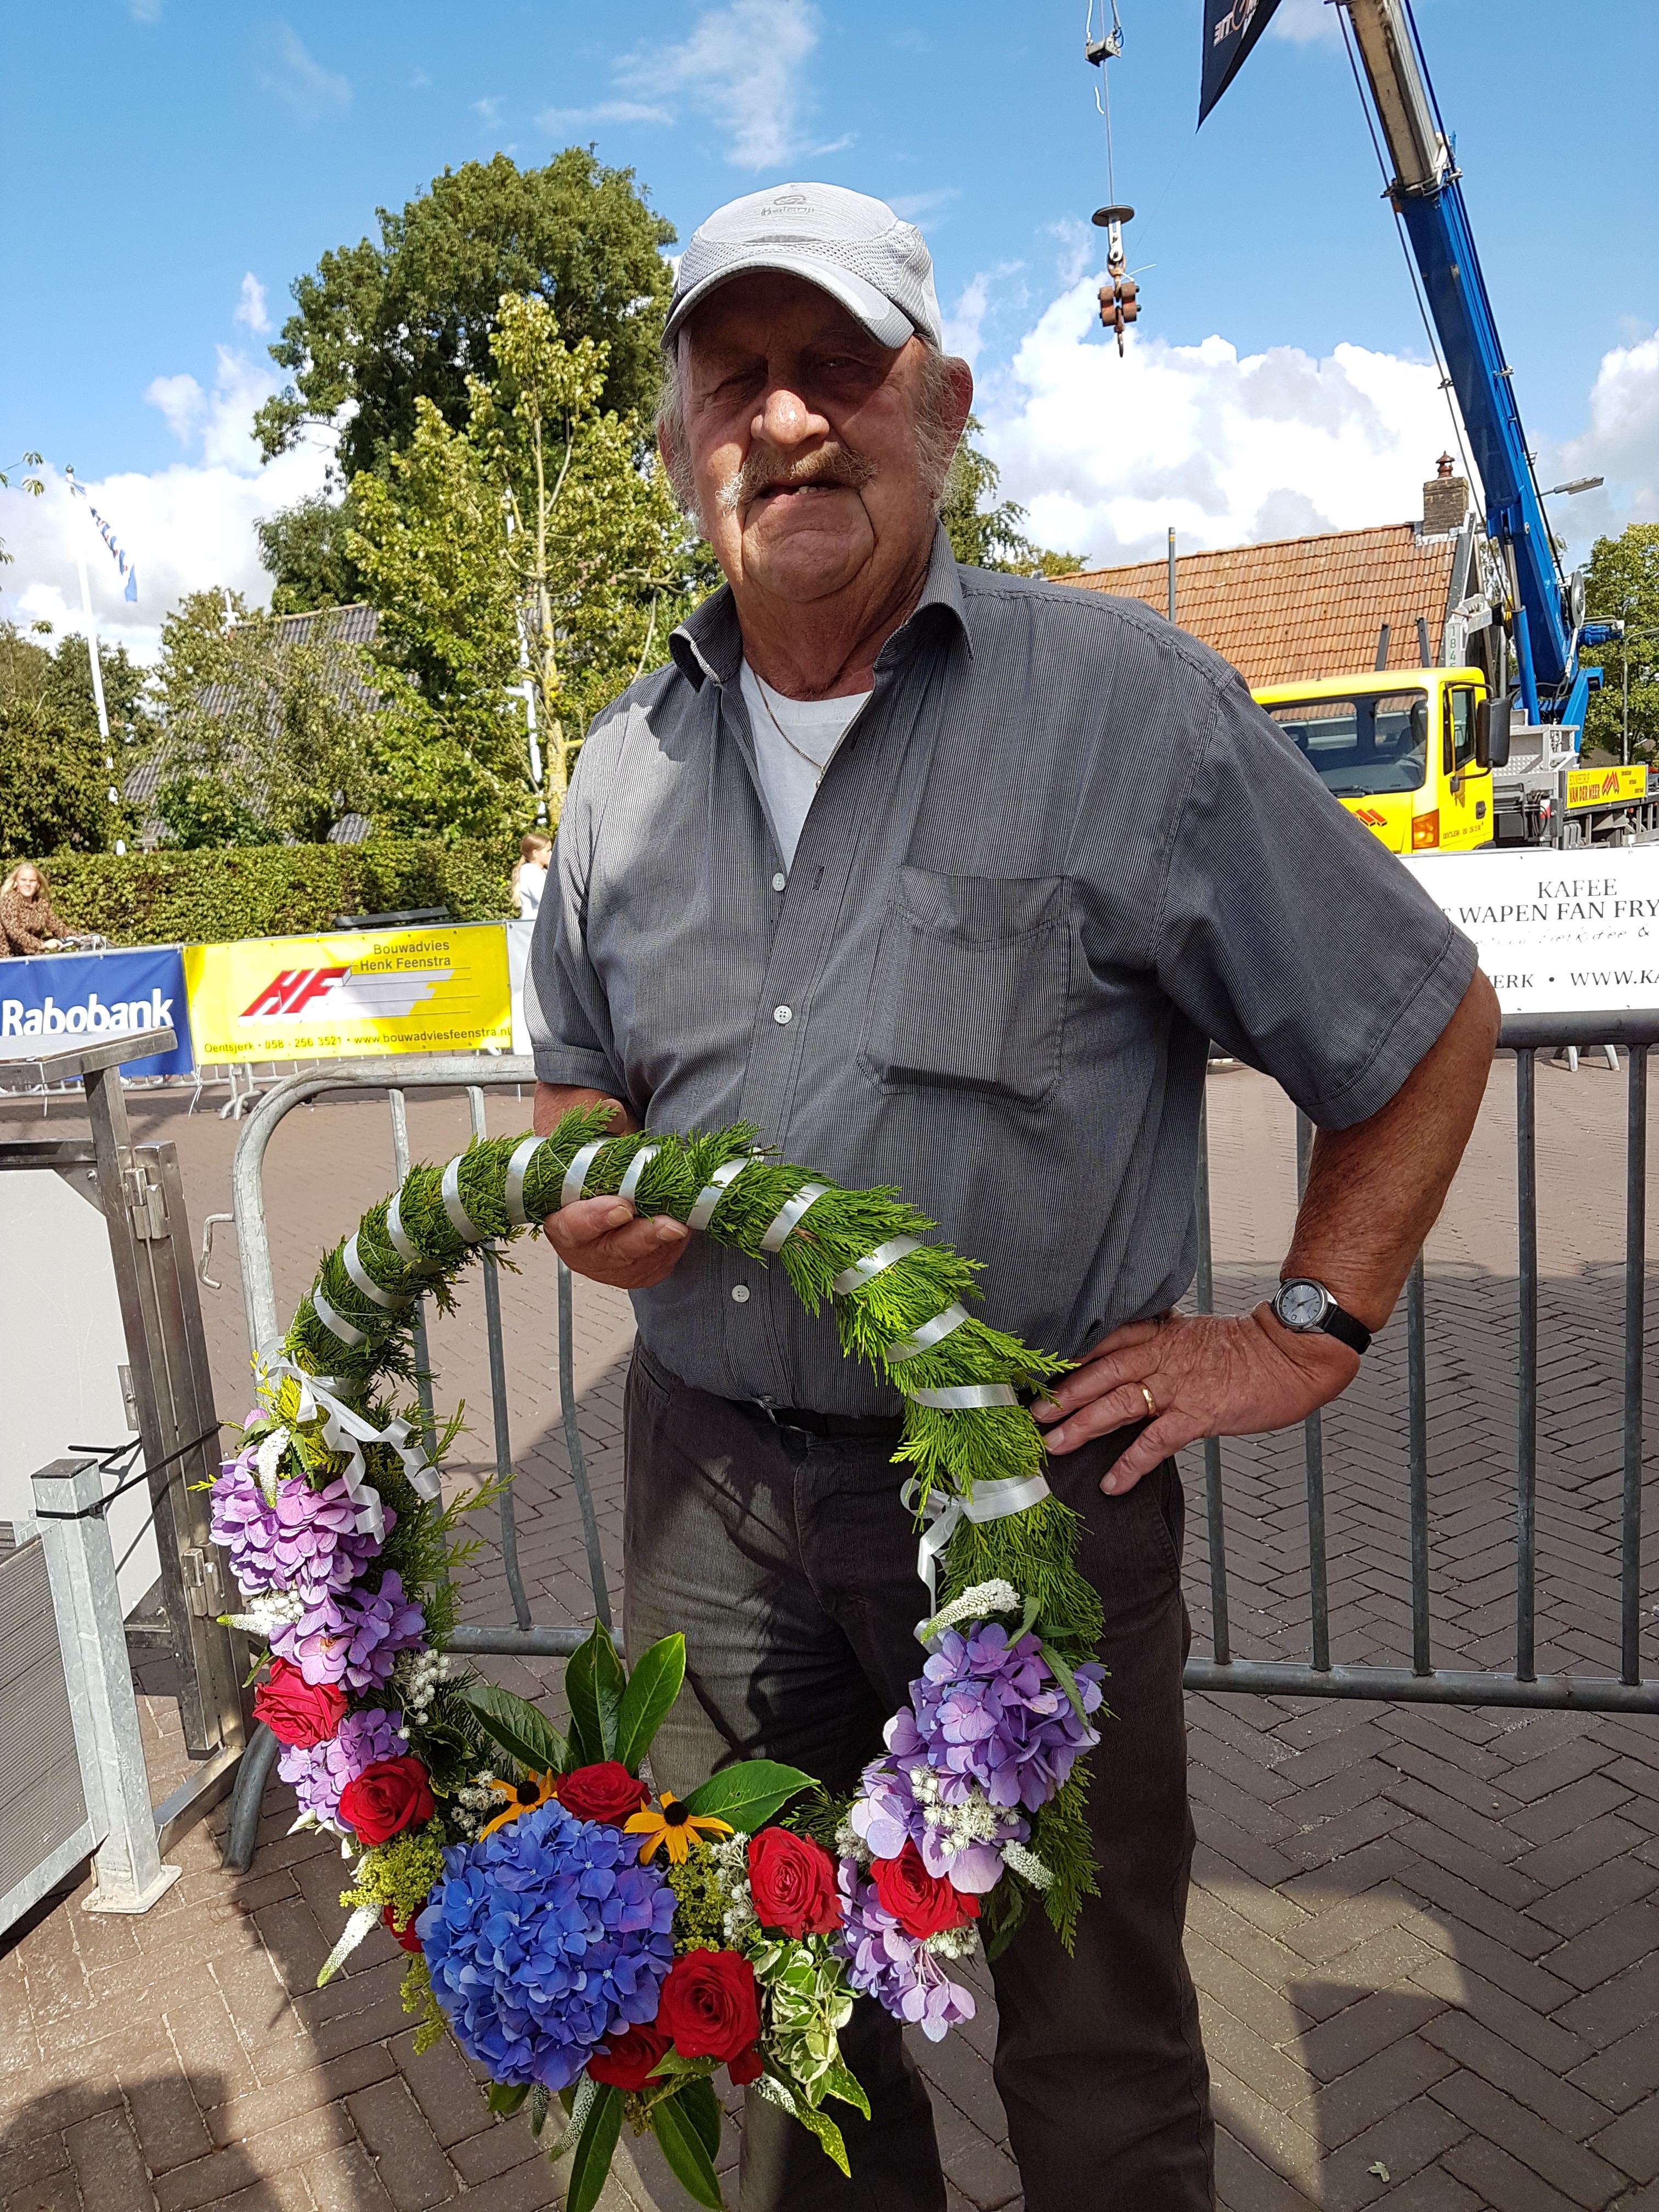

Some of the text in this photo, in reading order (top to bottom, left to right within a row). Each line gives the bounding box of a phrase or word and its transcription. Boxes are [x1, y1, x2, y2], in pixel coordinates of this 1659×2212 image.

[1570, 787, 1578, 803] VAN
[1579, 785, 1588, 802] DER
[1538, 878, 1617, 899] KAFEE
[1459, 904, 1548, 924] WAPEN
[1557, 901, 1605, 920] FAN
[374, 940, 450, 955] Bouwadvies
[360, 956, 451, 971] Henk Feenstra
[238, 966, 351, 1020] HF
[2, 988, 174, 1037] Rabobank
[204, 1026, 511, 1053] Oentsjerk 058 256 3521 www.bouwadviesfeenstra.nl
